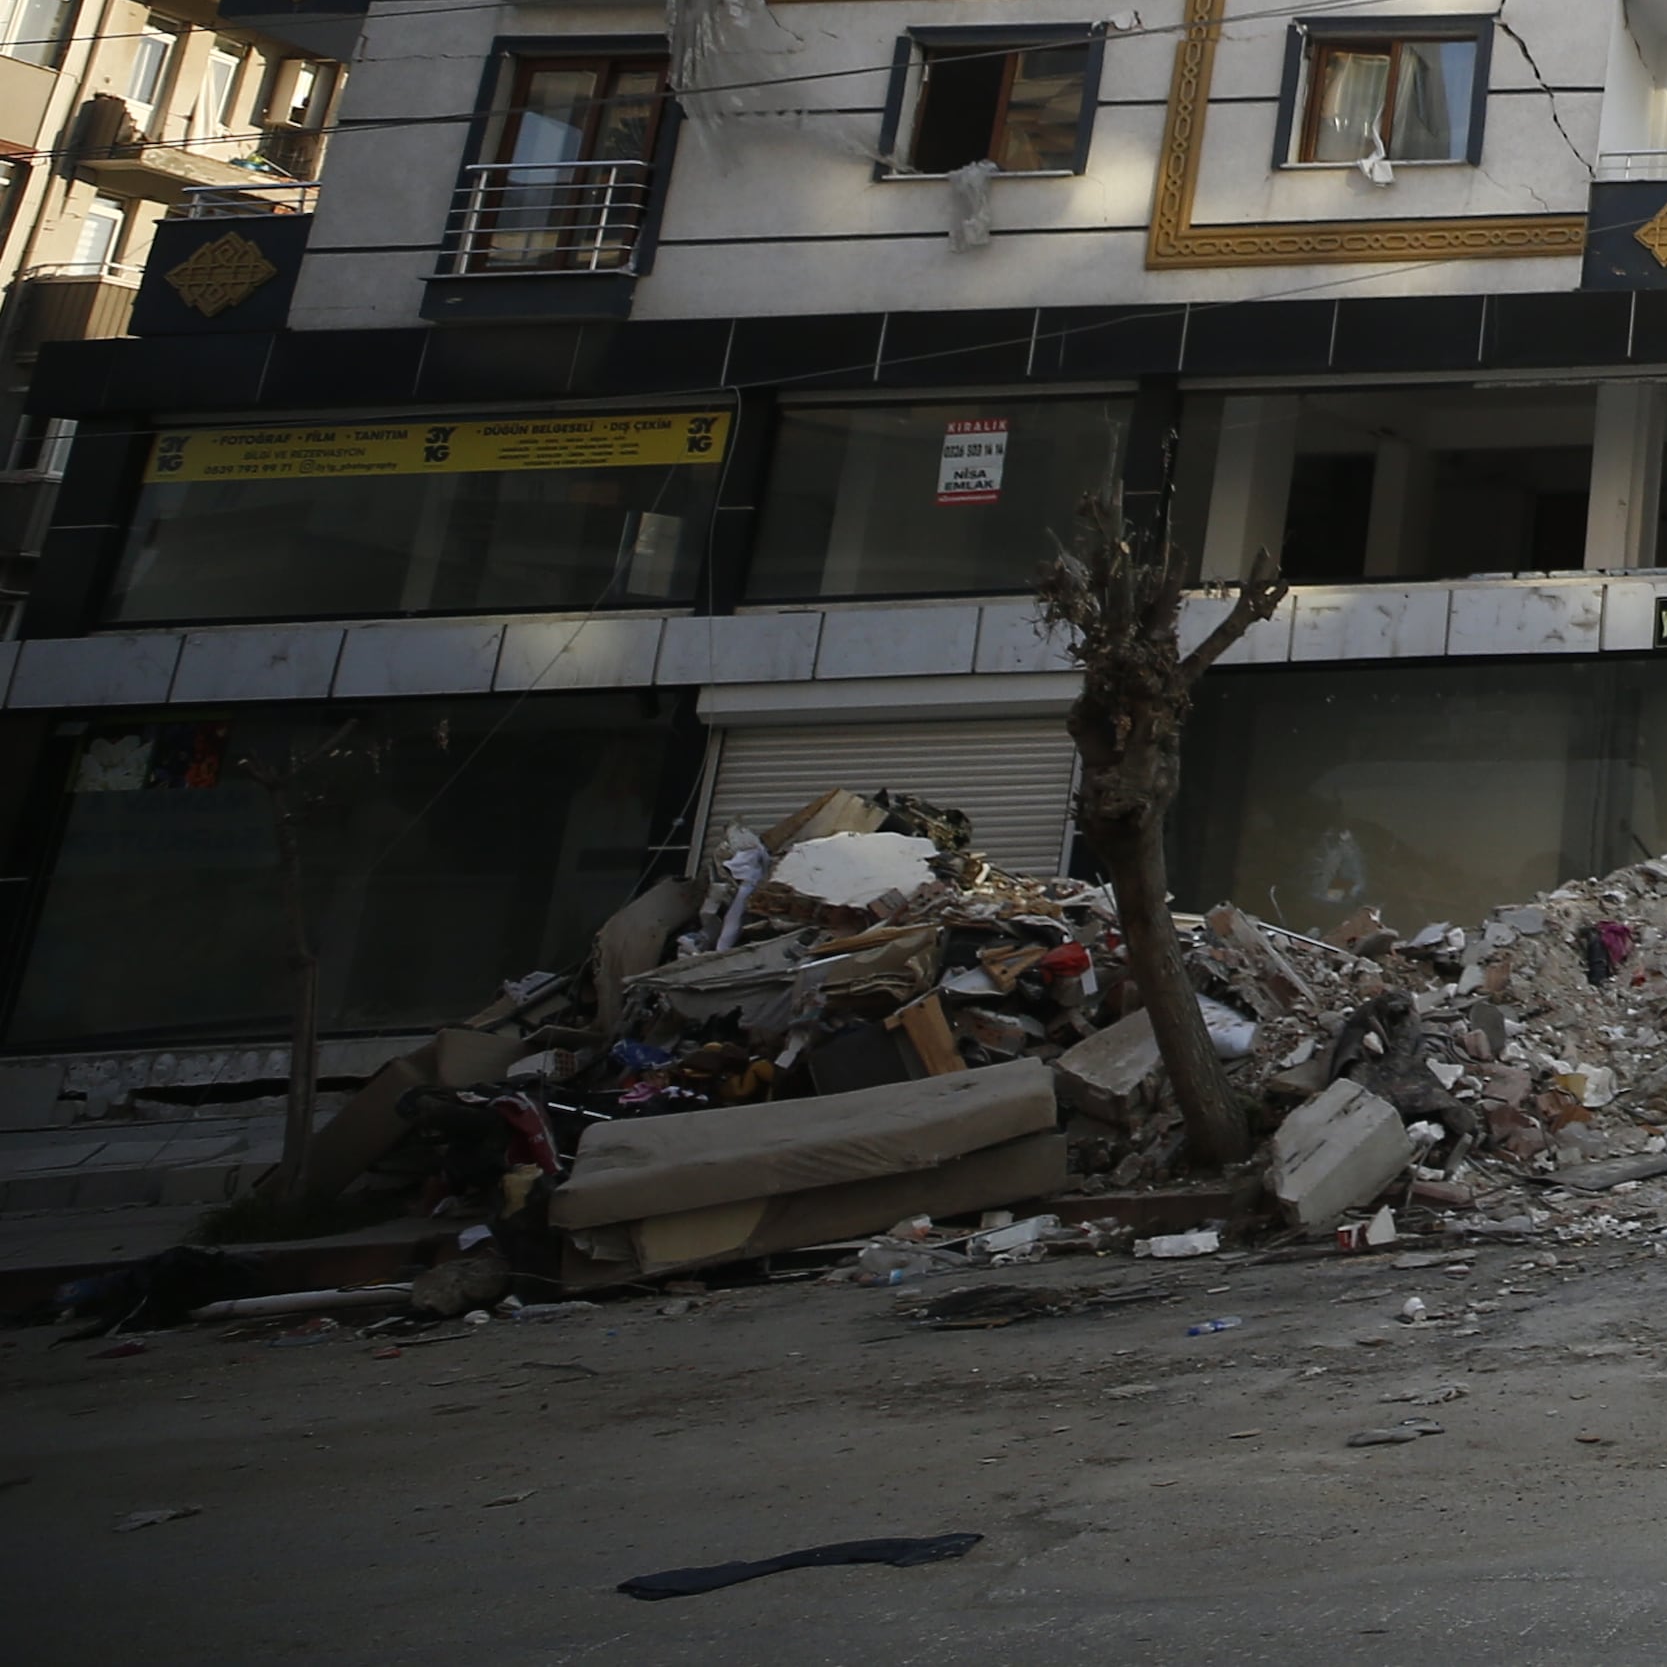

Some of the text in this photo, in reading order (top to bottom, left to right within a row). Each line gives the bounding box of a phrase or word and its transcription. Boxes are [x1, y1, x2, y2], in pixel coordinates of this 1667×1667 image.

[948, 420, 1007, 432] KIRALIK
[219, 429, 409, 446] FOTOĞRAF FİLM TANITIM
[954, 467, 986, 480] NİSA
[944, 481, 994, 490] EMLAK
